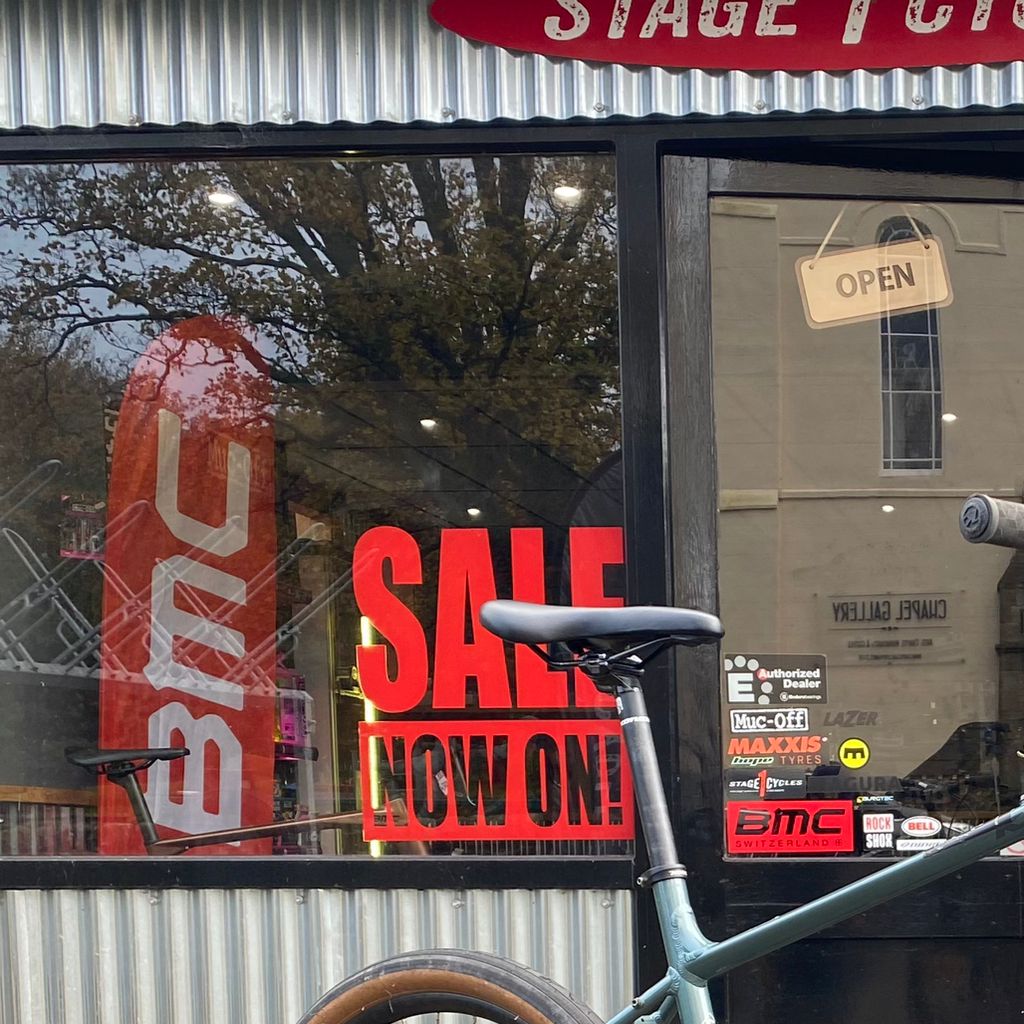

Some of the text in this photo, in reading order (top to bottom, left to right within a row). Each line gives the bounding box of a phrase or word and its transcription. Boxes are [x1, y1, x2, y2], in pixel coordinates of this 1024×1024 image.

[835, 262, 916, 298] OPEN
[142, 407, 251, 848] BMC
[352, 525, 625, 713] SALE
[758, 667, 820, 680] Authorized
[783, 679, 821, 689] Dealer
[734, 710, 804, 729] Muc-Off
[823, 710, 879, 728] LAZER
[728, 736, 821, 755] MAXXIS
[779, 755, 822, 765] TYRES
[369, 734, 508, 829] NOW
[525, 732, 623, 829] ON!
[729, 778, 760, 789] STAGE
[758, 769, 768, 798] 1
[766, 777, 803, 789] CYCLES
[735, 808, 846, 835] BMC
[866, 817, 891, 830] ROCK
[908, 822, 935, 831] BELL
[735, 839, 829, 848] SWITZERLAND
[866, 833, 892, 848] SHOX
